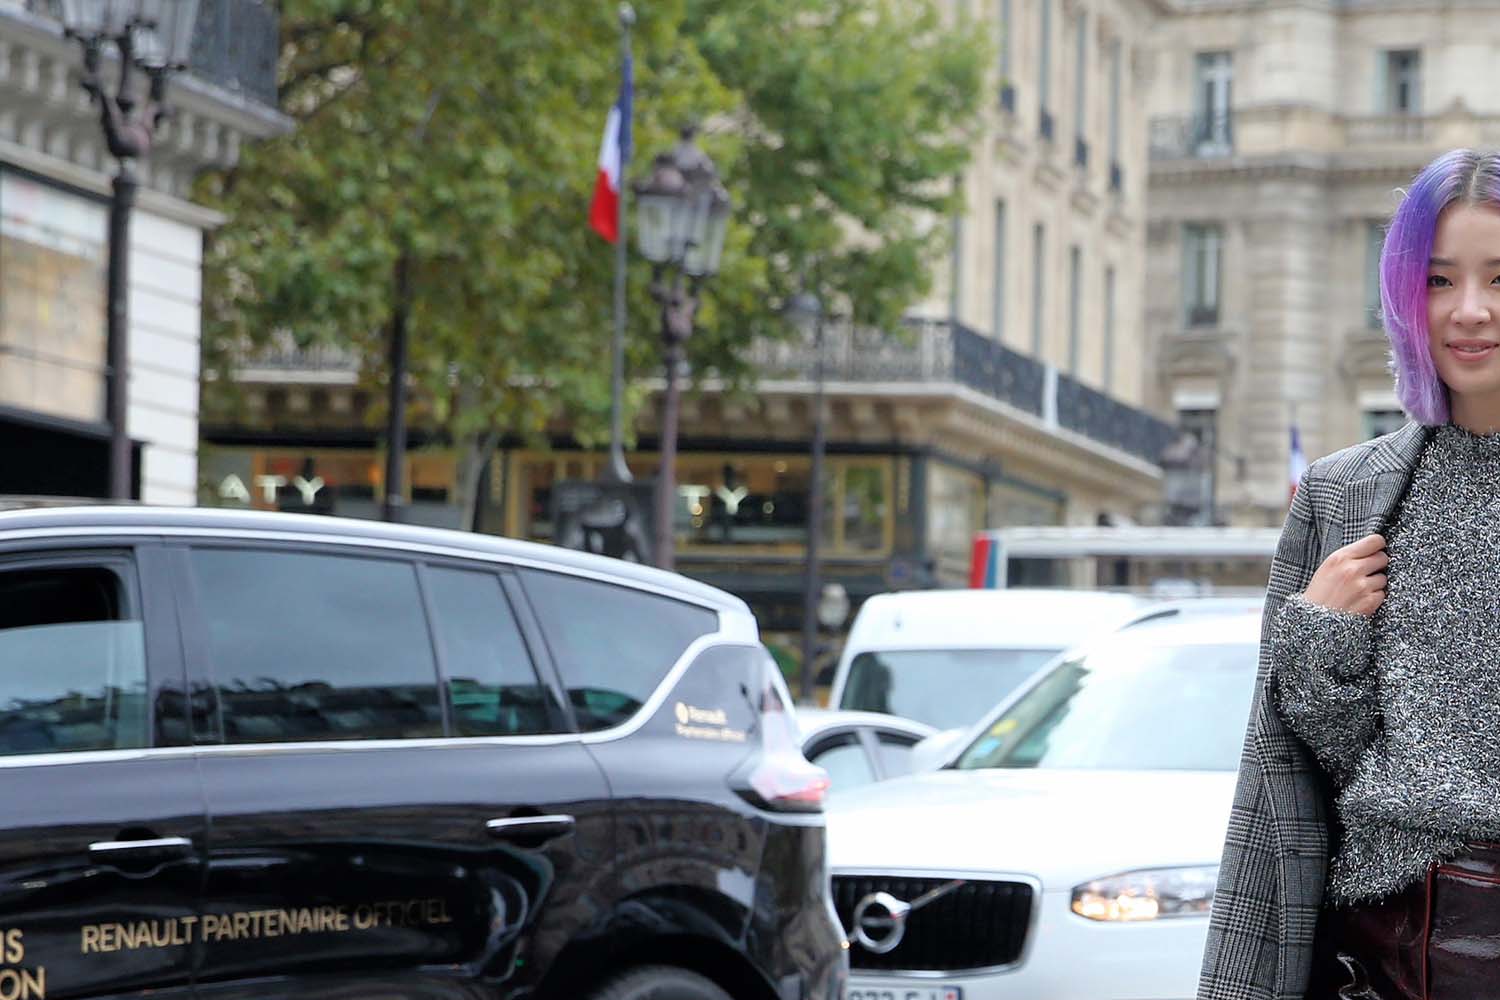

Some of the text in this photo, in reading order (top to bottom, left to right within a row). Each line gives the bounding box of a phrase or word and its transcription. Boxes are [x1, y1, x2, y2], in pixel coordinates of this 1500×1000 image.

[81, 898, 454, 954] RENAULT PARTENAIRE OFFICIEL
